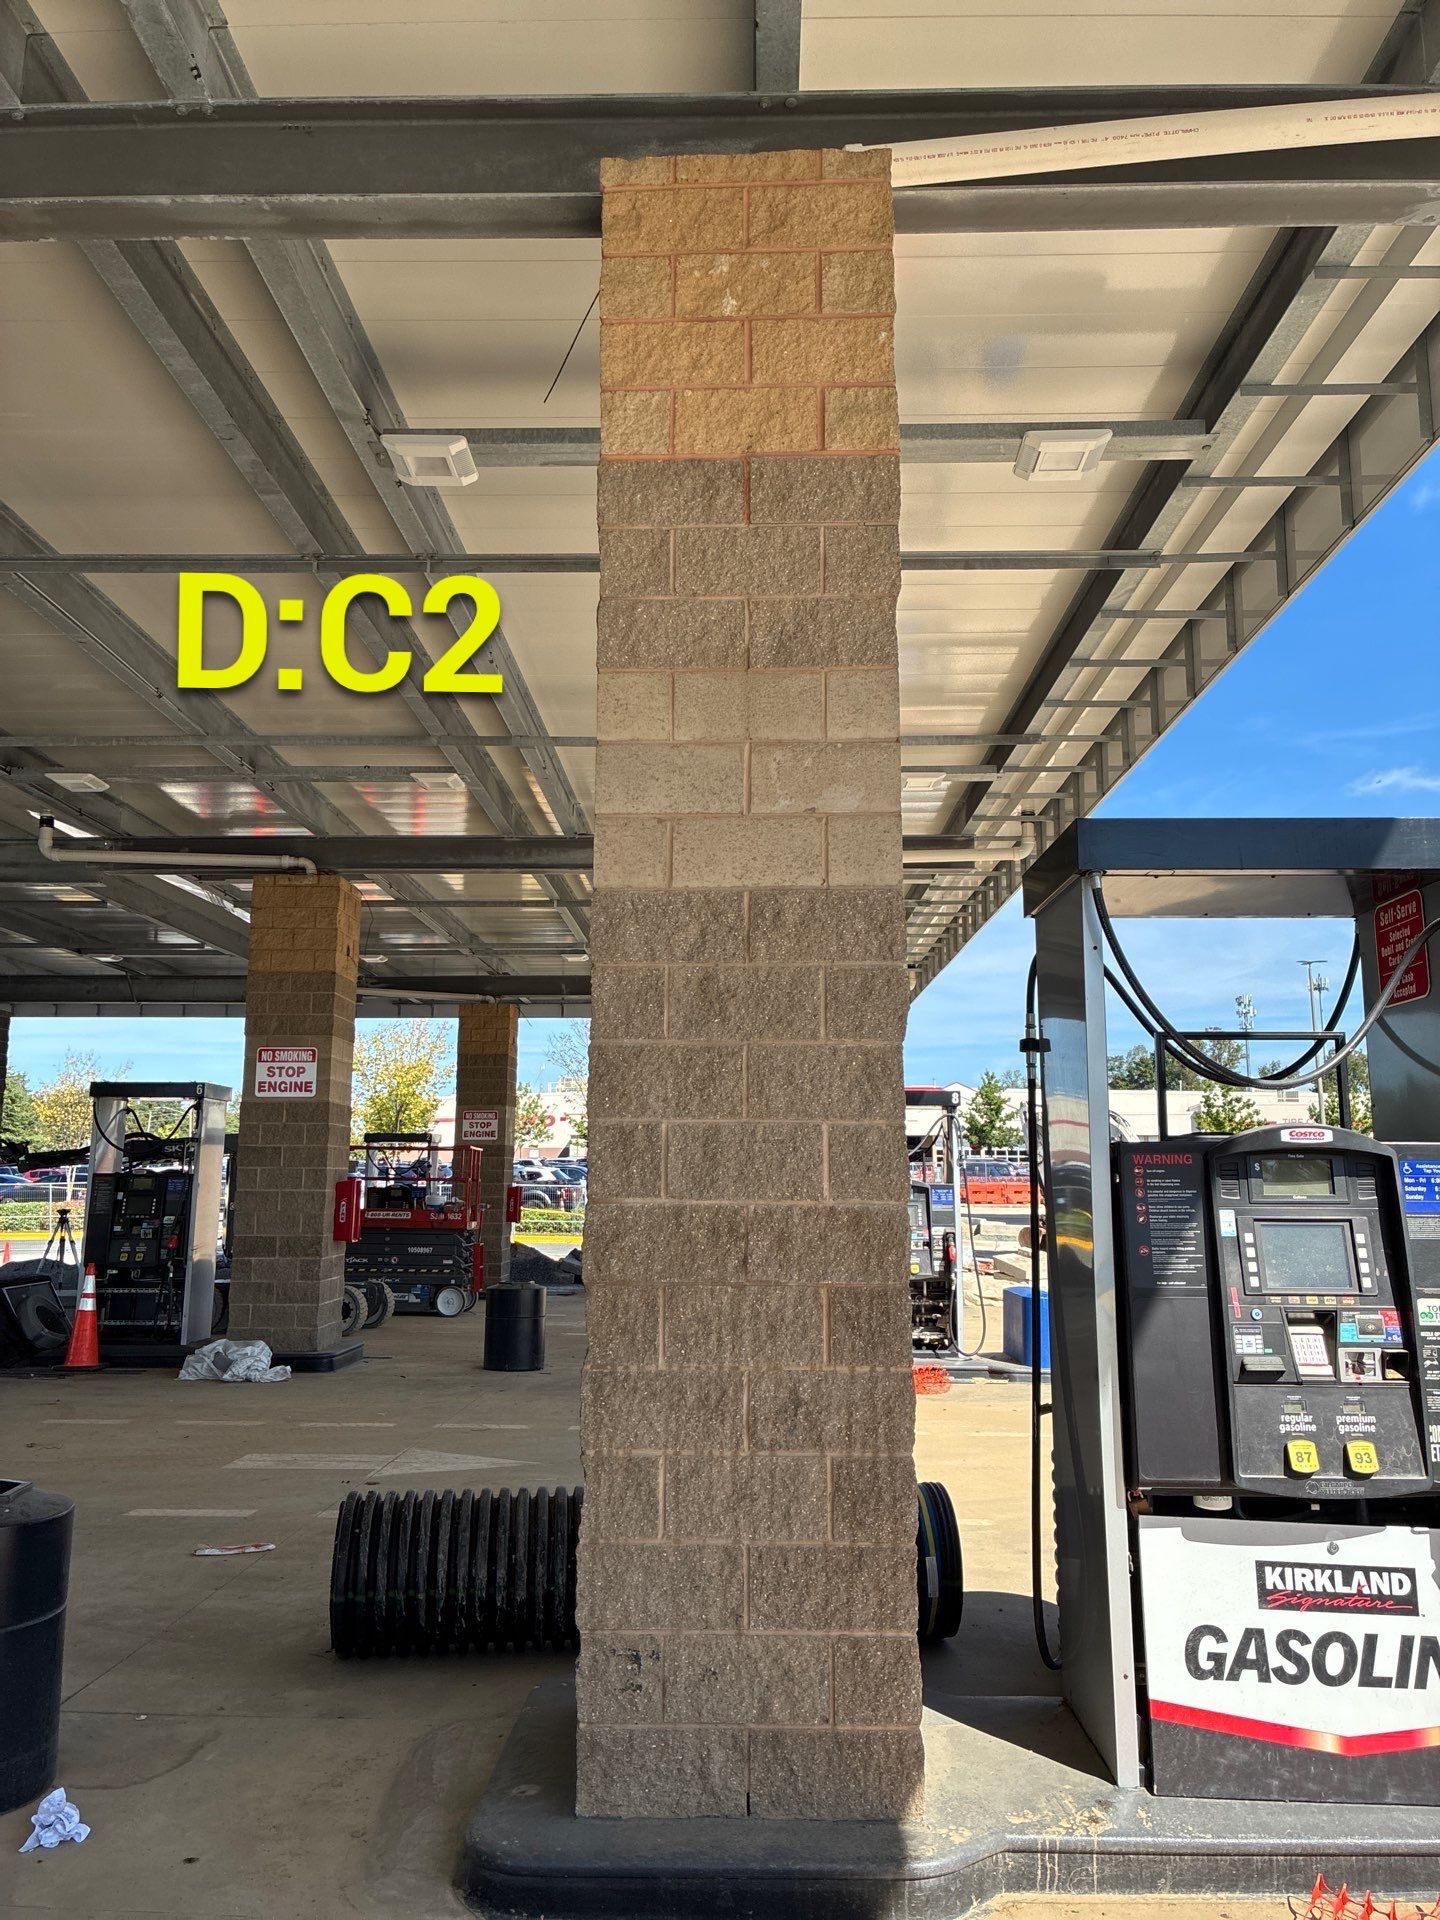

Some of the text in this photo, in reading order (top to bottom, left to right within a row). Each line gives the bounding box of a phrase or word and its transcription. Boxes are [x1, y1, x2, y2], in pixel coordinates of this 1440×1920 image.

[1380, 901, 1417, 926] Self-Serve
[1389, 925, 1411, 942] Selected
[1381, 945, 1394, 957] Debit
[1395, 942, 1404, 952] and
[261, 1050, 313, 1061] NO SMOKING
[266, 1066, 306, 1078] STOP
[196, 1084, 203, 1095] 6
[257, 1081, 313, 1093] ENGINE
[951, 1092, 959, 1104] 8
[465, 1112, 496, 1120] NO SMOKING
[468, 1121, 492, 1129] STOP
[1288, 1130, 1325, 1138] COSTCO
[1132, 1154, 1193, 1165] WARNING
[1254, 1162, 1260, 1171] $
[1280, 1413, 1313, 1425] regular
[1336, 1413, 1376, 1426] premium
[1279, 1423, 1317, 1433] gasoline
[1338, 1423, 1376, 1434] gasoline
[1295, 1451, 1312, 1463] 87
[1354, 1452, 1373, 1464] 93
[1264, 1566, 1412, 1596] KIRKLAND
[1266, 1590, 1413, 1612] Signature
